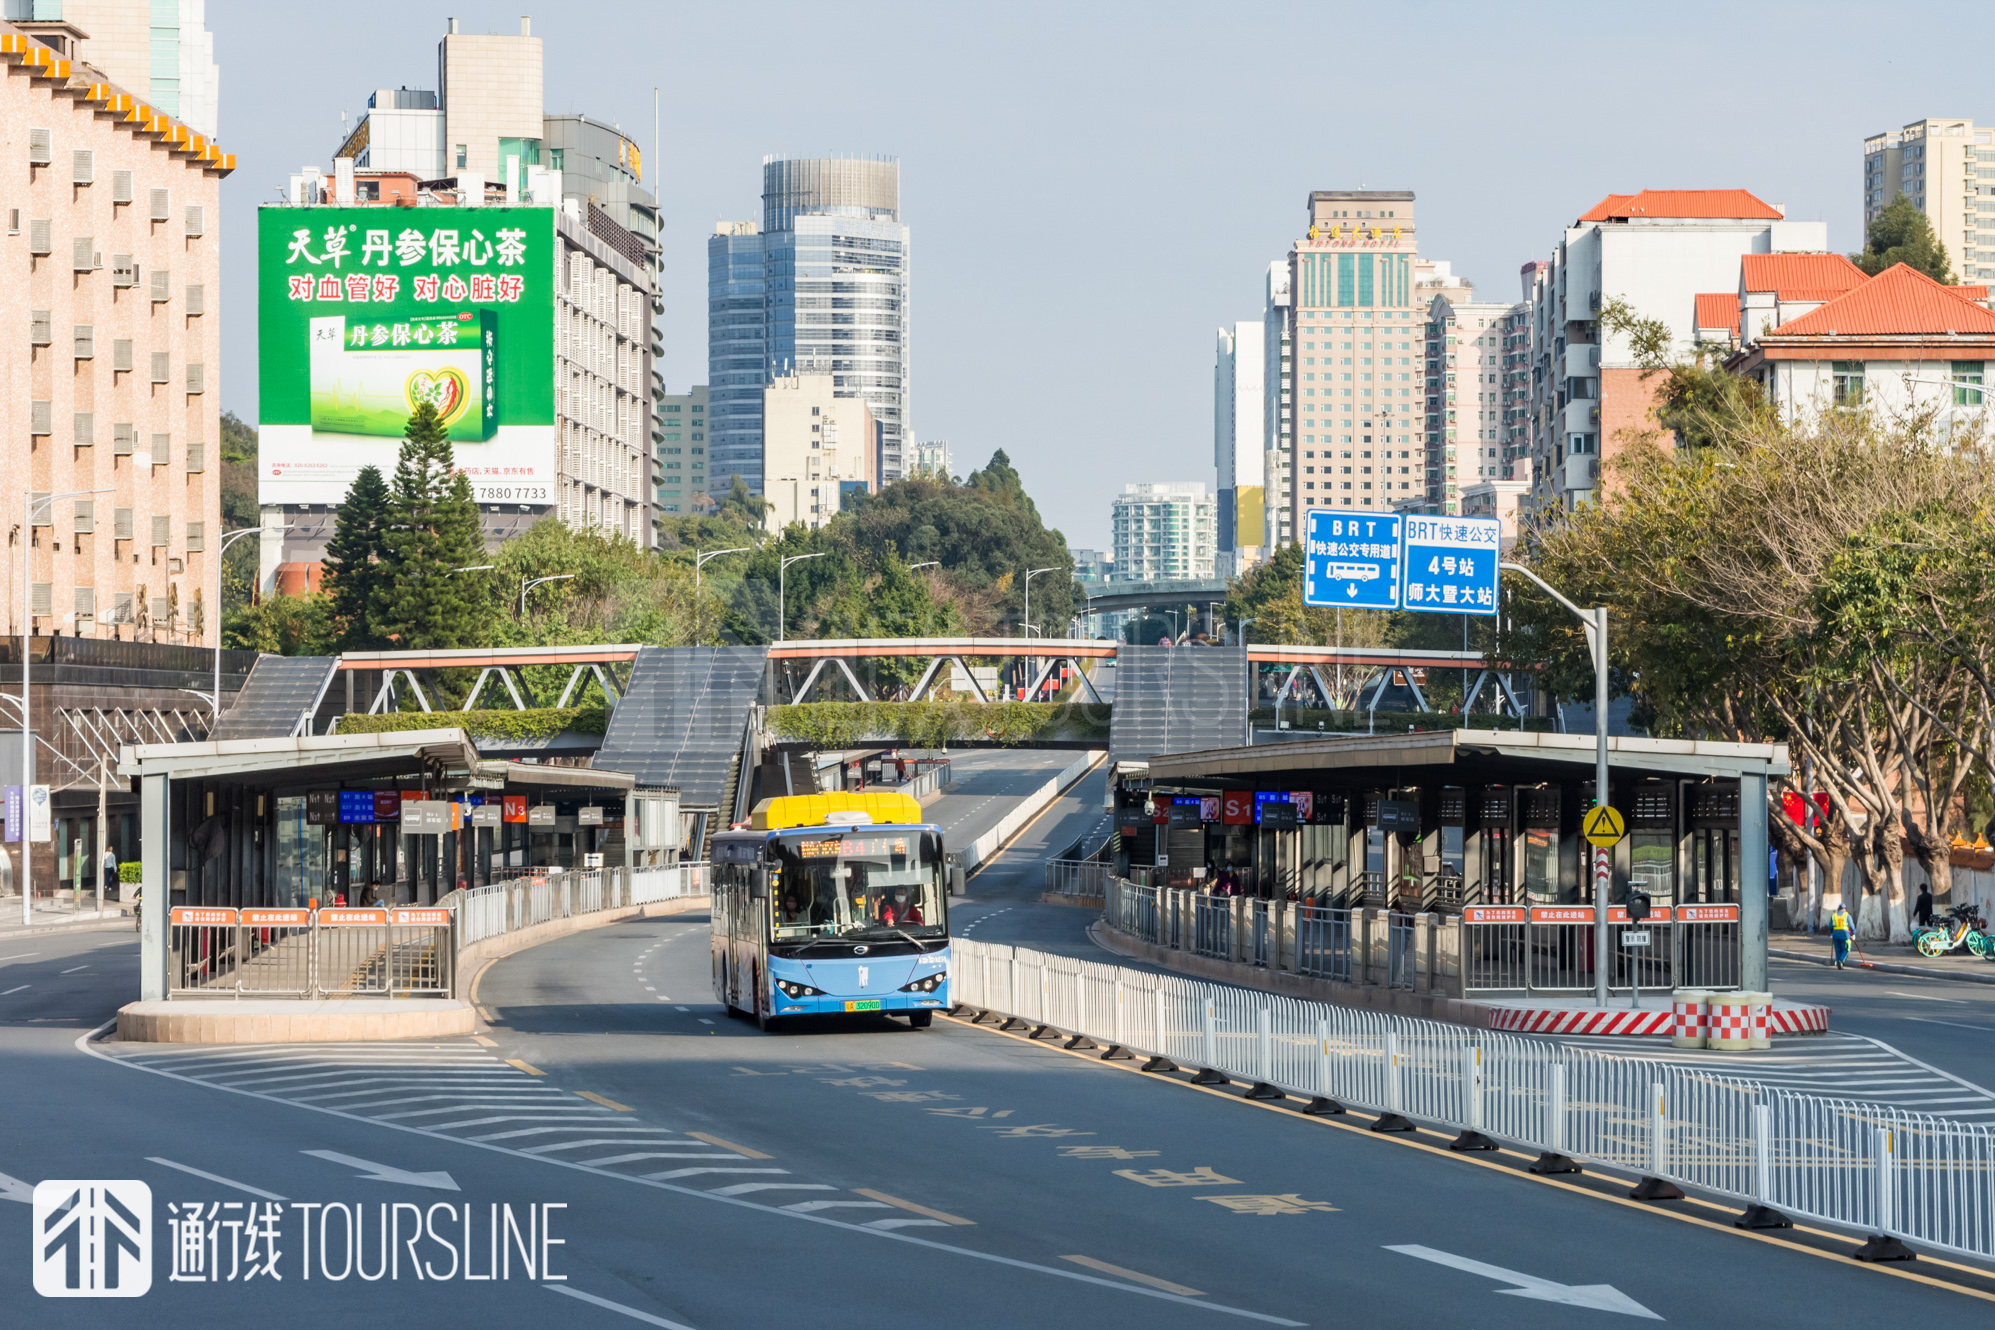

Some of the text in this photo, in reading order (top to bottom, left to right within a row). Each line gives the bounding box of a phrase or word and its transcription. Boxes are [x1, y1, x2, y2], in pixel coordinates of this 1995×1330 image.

[361, 228, 527, 267] 丹参保心茶
[1361, 240, 1401, 249] HOTEL
[288, 273, 525, 302] 对血管好 对心脏好
[315, 327, 337, 342] 天草
[350, 321, 459, 347] 丹参保心茶
[480, 487, 546, 499] 7880 7733
[1332, 520, 1377, 538] BRT
[1408, 521, 1497, 544] BRT快速公交
[1315, 541, 1392, 559] 快速公交专用道
[1428, 555, 1475, 577] 4号站
[1408, 583, 1493, 606] 师大暨大站
[309, 794, 332, 804] N1 N2
[1225, 799, 1251, 817] S1
[505, 802, 525, 816] N3
[252, 913, 298, 921] 禁止在此进站
[330, 913, 376, 921] 禁止在此进站
[1540, 911, 1585, 919] 禁止在此进站
